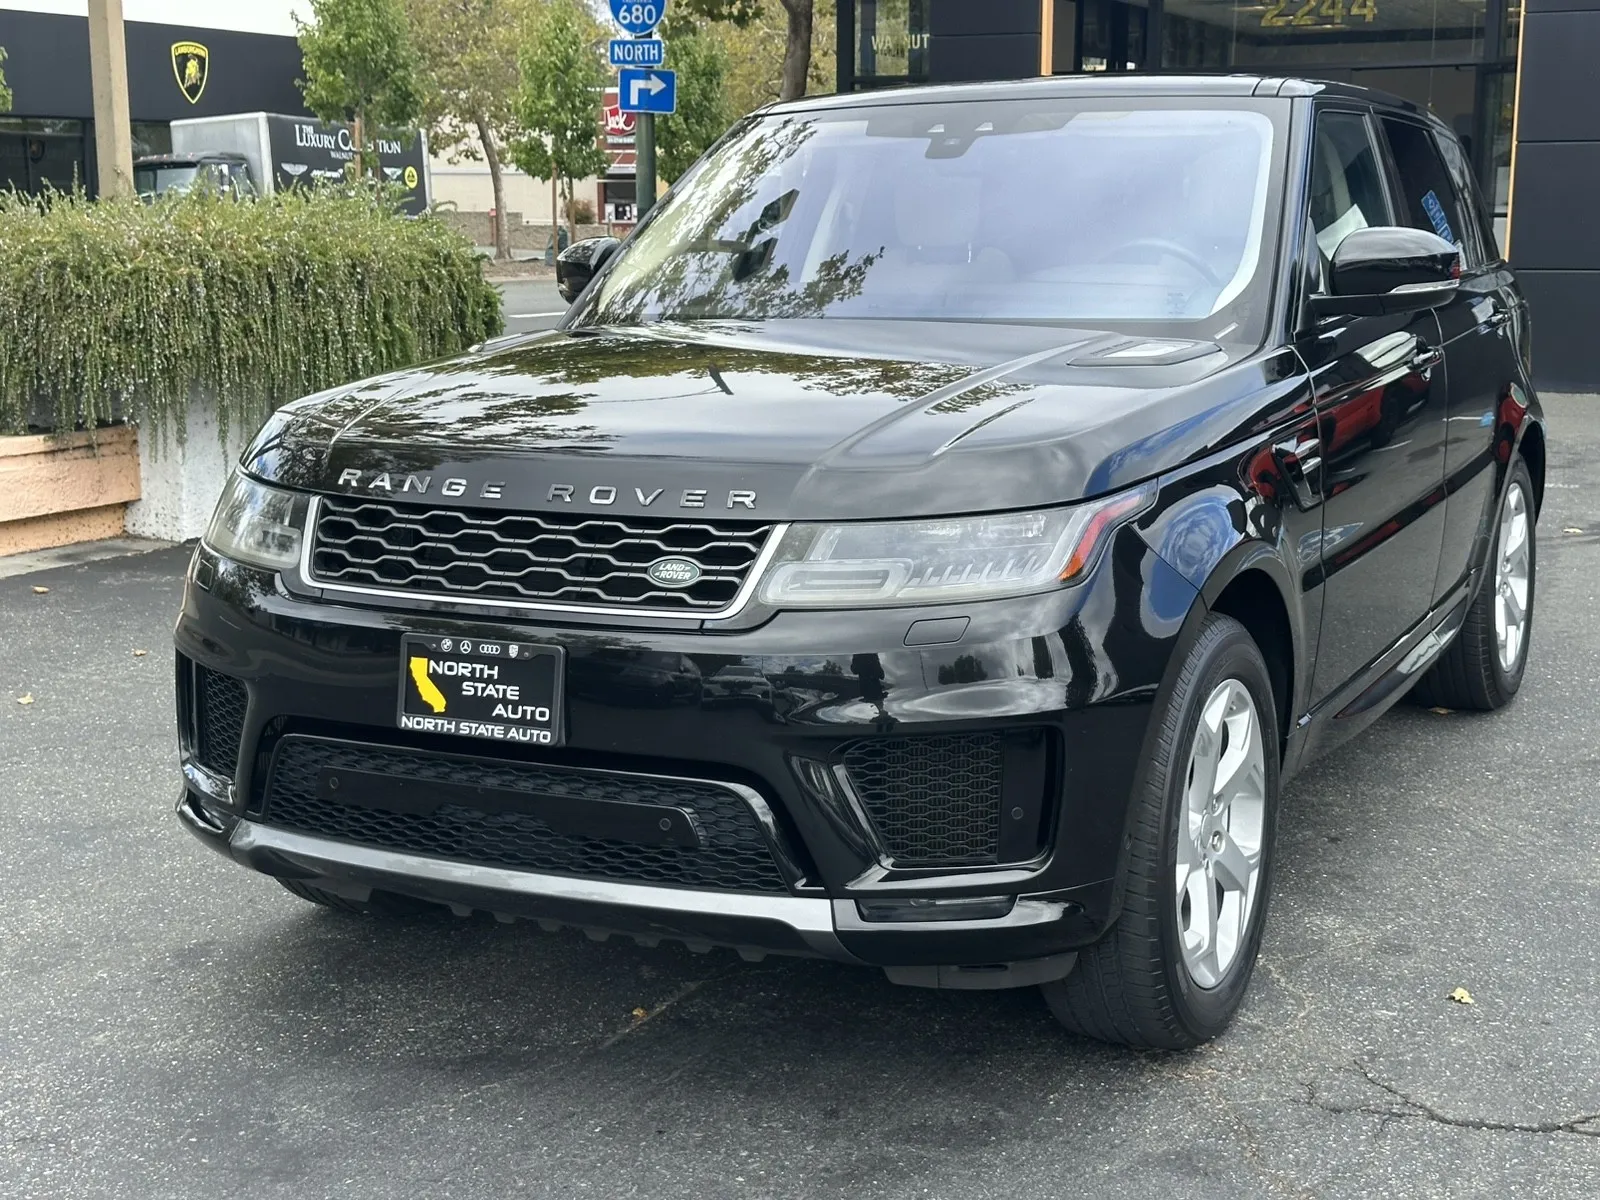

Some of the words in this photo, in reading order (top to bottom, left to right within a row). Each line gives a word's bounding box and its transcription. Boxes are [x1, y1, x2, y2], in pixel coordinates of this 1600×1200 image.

[619, 4, 656, 25] 680
[871, 33, 931, 51] WANUT
[614, 43, 659, 61] NORTH
[295, 124, 336, 149] LUXURY
[338, 129, 402, 154] COTION
[337, 468, 506, 499] RANGE
[547, 483, 757, 509] ROVER
[659, 563, 685, 571] LAND
[660, 570, 691, 580] ROVER
[429, 659, 499, 679] NORTH
[461, 681, 520, 700] STATE
[492, 703, 550, 721] AUTO
[401, 715, 456, 734] NORTH
[459, 721, 504, 738] STATE
[506, 727, 551, 744] AUTO
